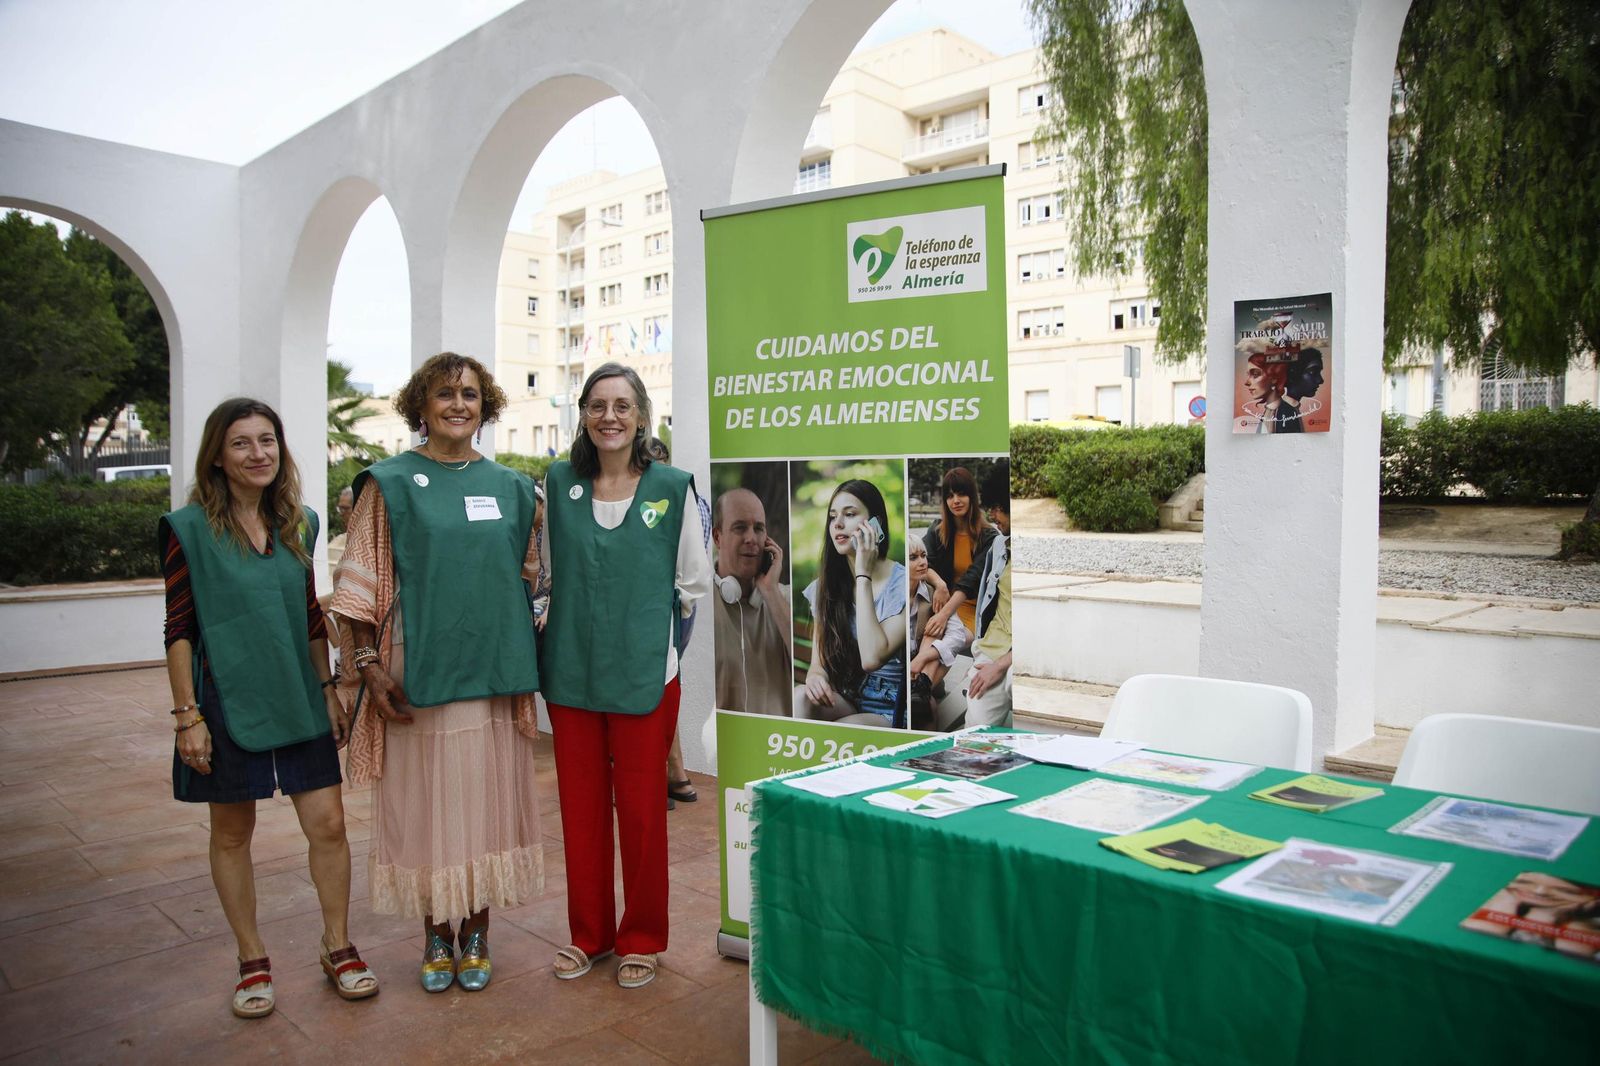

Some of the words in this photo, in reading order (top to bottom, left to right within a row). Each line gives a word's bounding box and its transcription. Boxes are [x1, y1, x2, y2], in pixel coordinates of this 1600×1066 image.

[905, 238, 956, 255] Teléfono
[959, 234, 973, 249] de
[905, 256, 916, 270] la
[920, 252, 981, 271] esperanza
[902, 271, 964, 289] Almería
[1240, 329, 1281, 339] TRABAJO
[1289, 330, 1328, 341] MENTAL
[1292, 322, 1325, 332] SALUD
[756, 328, 884, 360] CUIDAMOS
[889, 325, 939, 350] DEL
[714, 368, 833, 397] BIENESTAR
[838, 359, 994, 389] EMOCIONAL
[725, 407, 755, 430] DE
[759, 405, 801, 427] LOS
[807, 397, 980, 426] ALMERIENSES
[767, 733, 815, 760] 950
